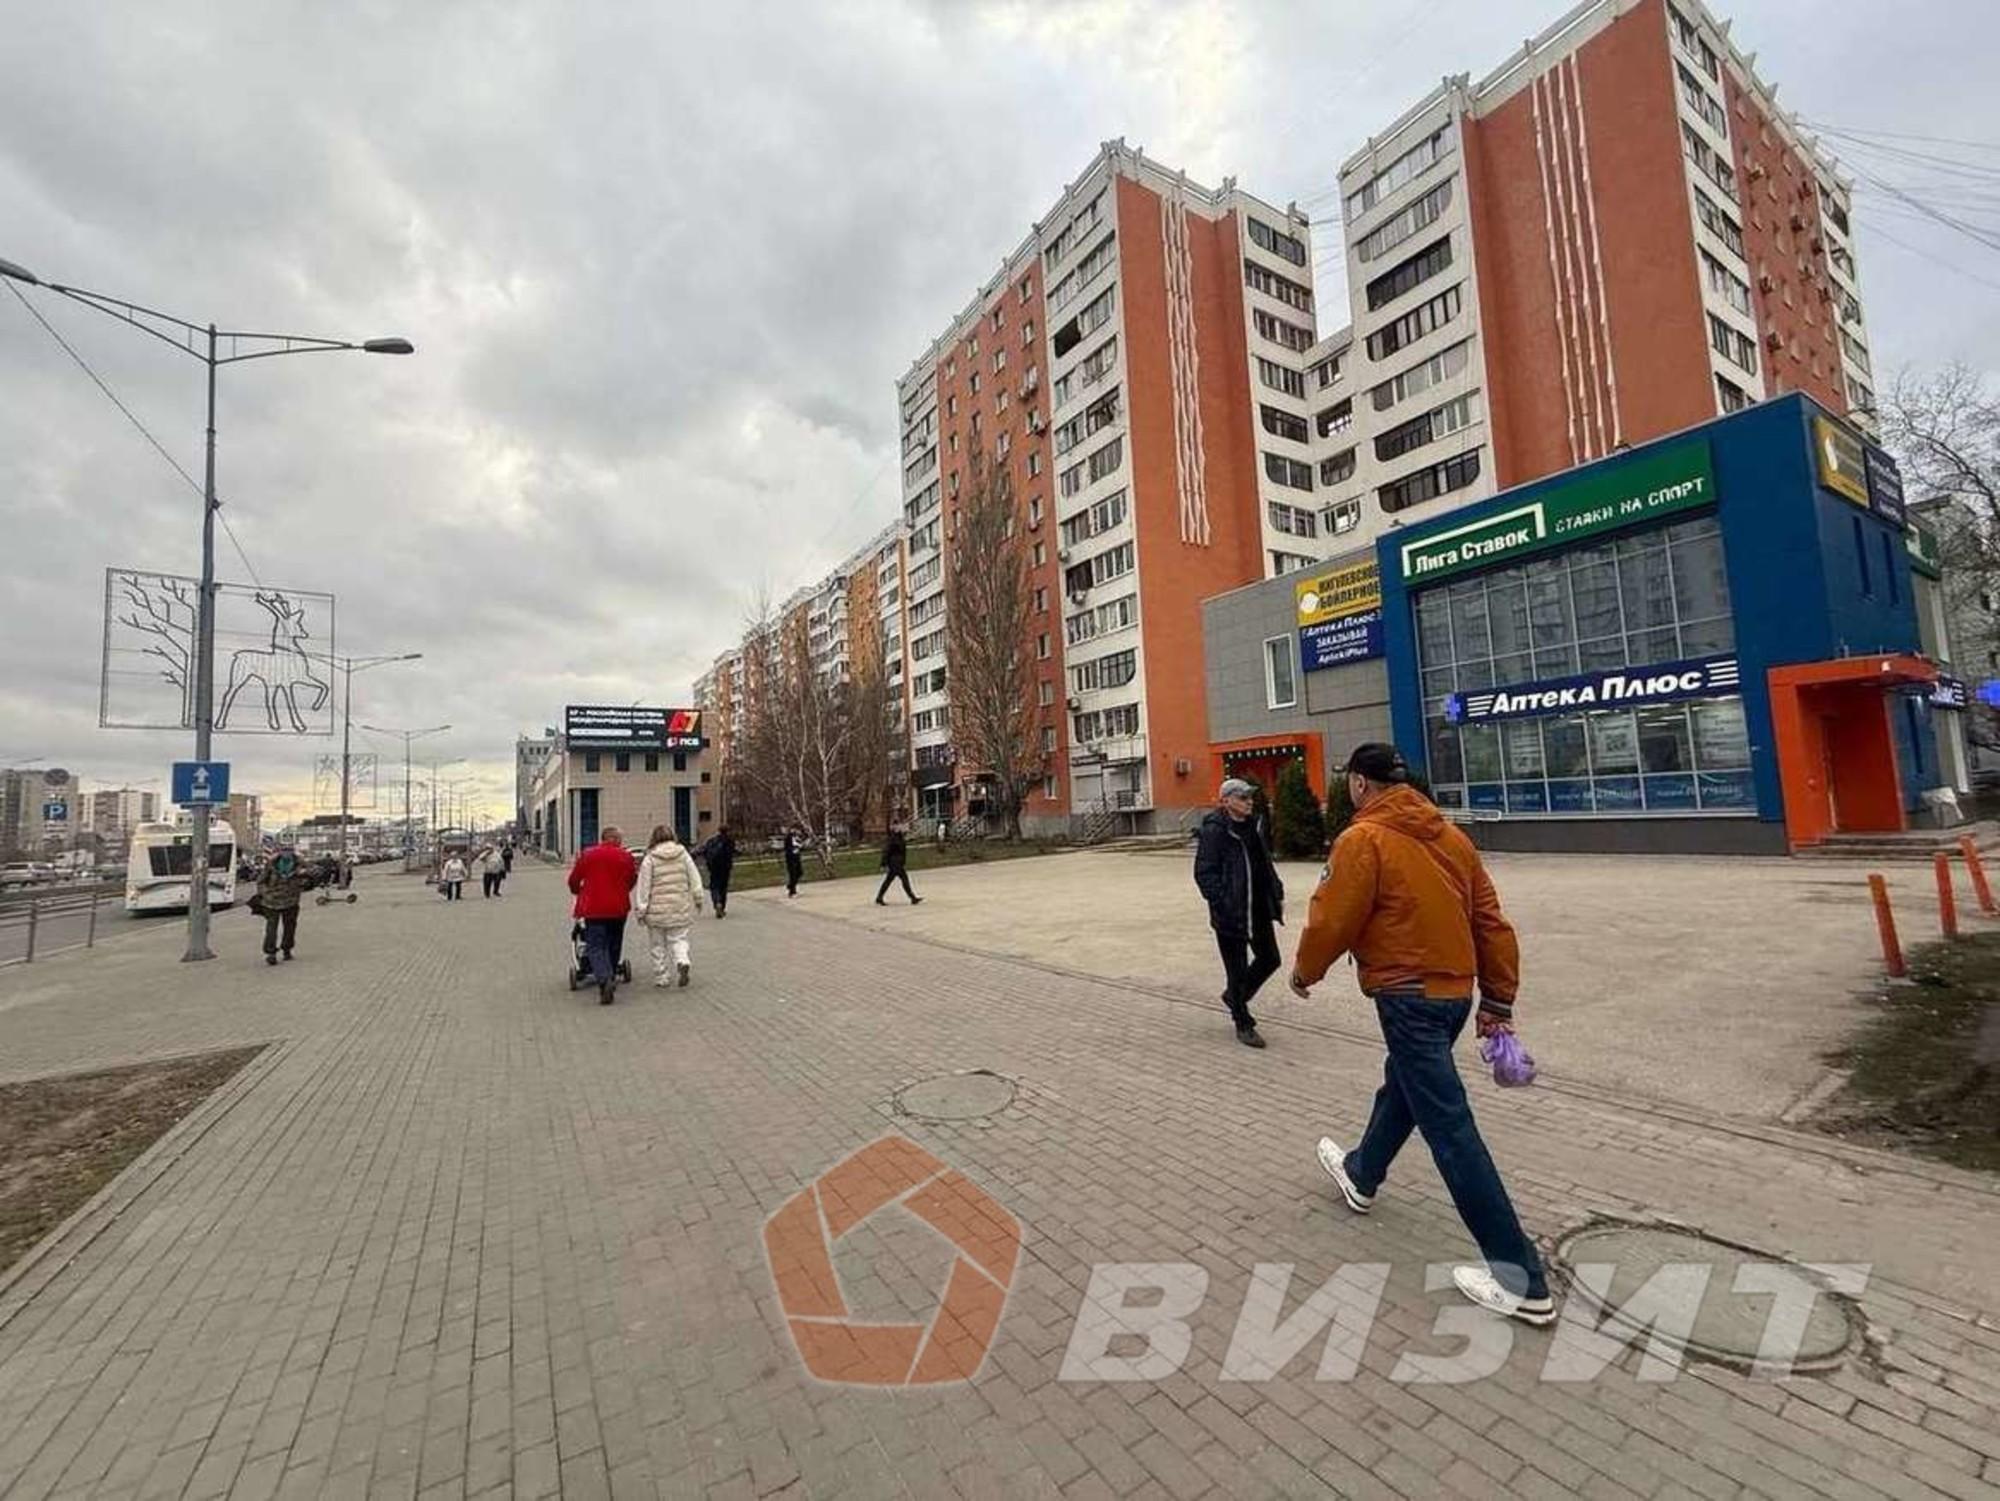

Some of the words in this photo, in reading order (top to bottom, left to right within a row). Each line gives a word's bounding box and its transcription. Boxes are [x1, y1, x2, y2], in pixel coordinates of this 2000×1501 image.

[1555, 504, 1613, 533] СТАВКИ
[1620, 497, 1643, 516] НА
[1648, 477, 1705, 506] СПОРТ
[1415, 548, 1458, 574] Лига
[1461, 528, 1531, 561] Ставок
